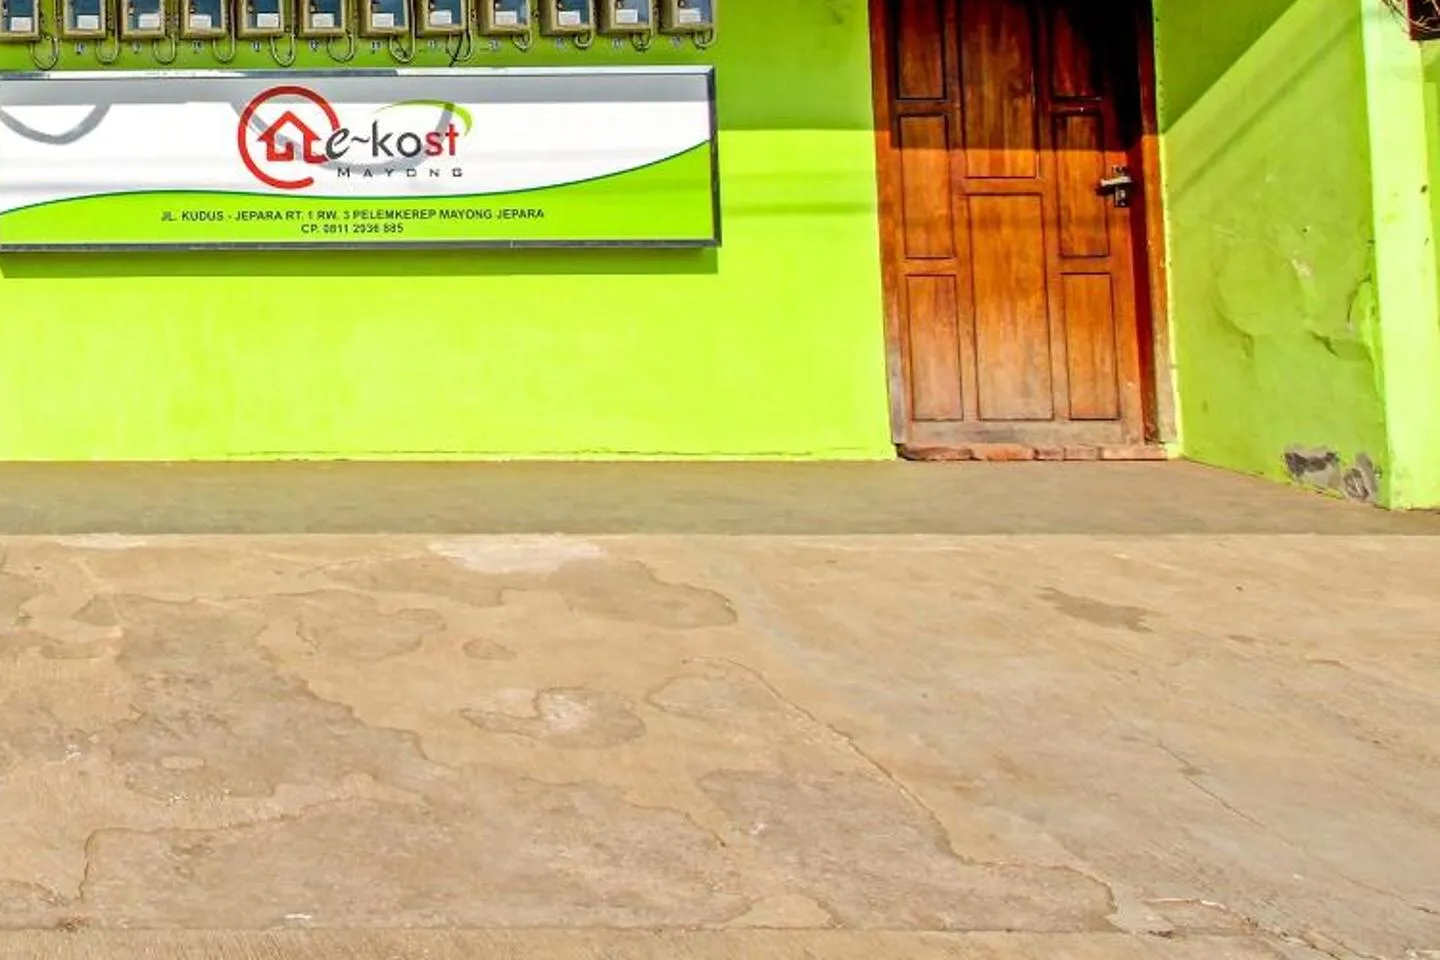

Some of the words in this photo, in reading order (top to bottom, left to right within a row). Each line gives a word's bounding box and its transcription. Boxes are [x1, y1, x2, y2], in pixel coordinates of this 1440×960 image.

[337, 167, 464, 178] MAYONG
[161, 211, 177, 222] JL.
[181, 211, 224, 222] KUDUS
[235, 210, 283, 221] JEPARA
[343, 210, 351, 220] 3
[353, 209, 437, 220] PELEMKEREP
[439, 208, 493, 220] MAYONG
[496, 208, 545, 219] JEPARA
[323, 223, 349, 234] 0811
